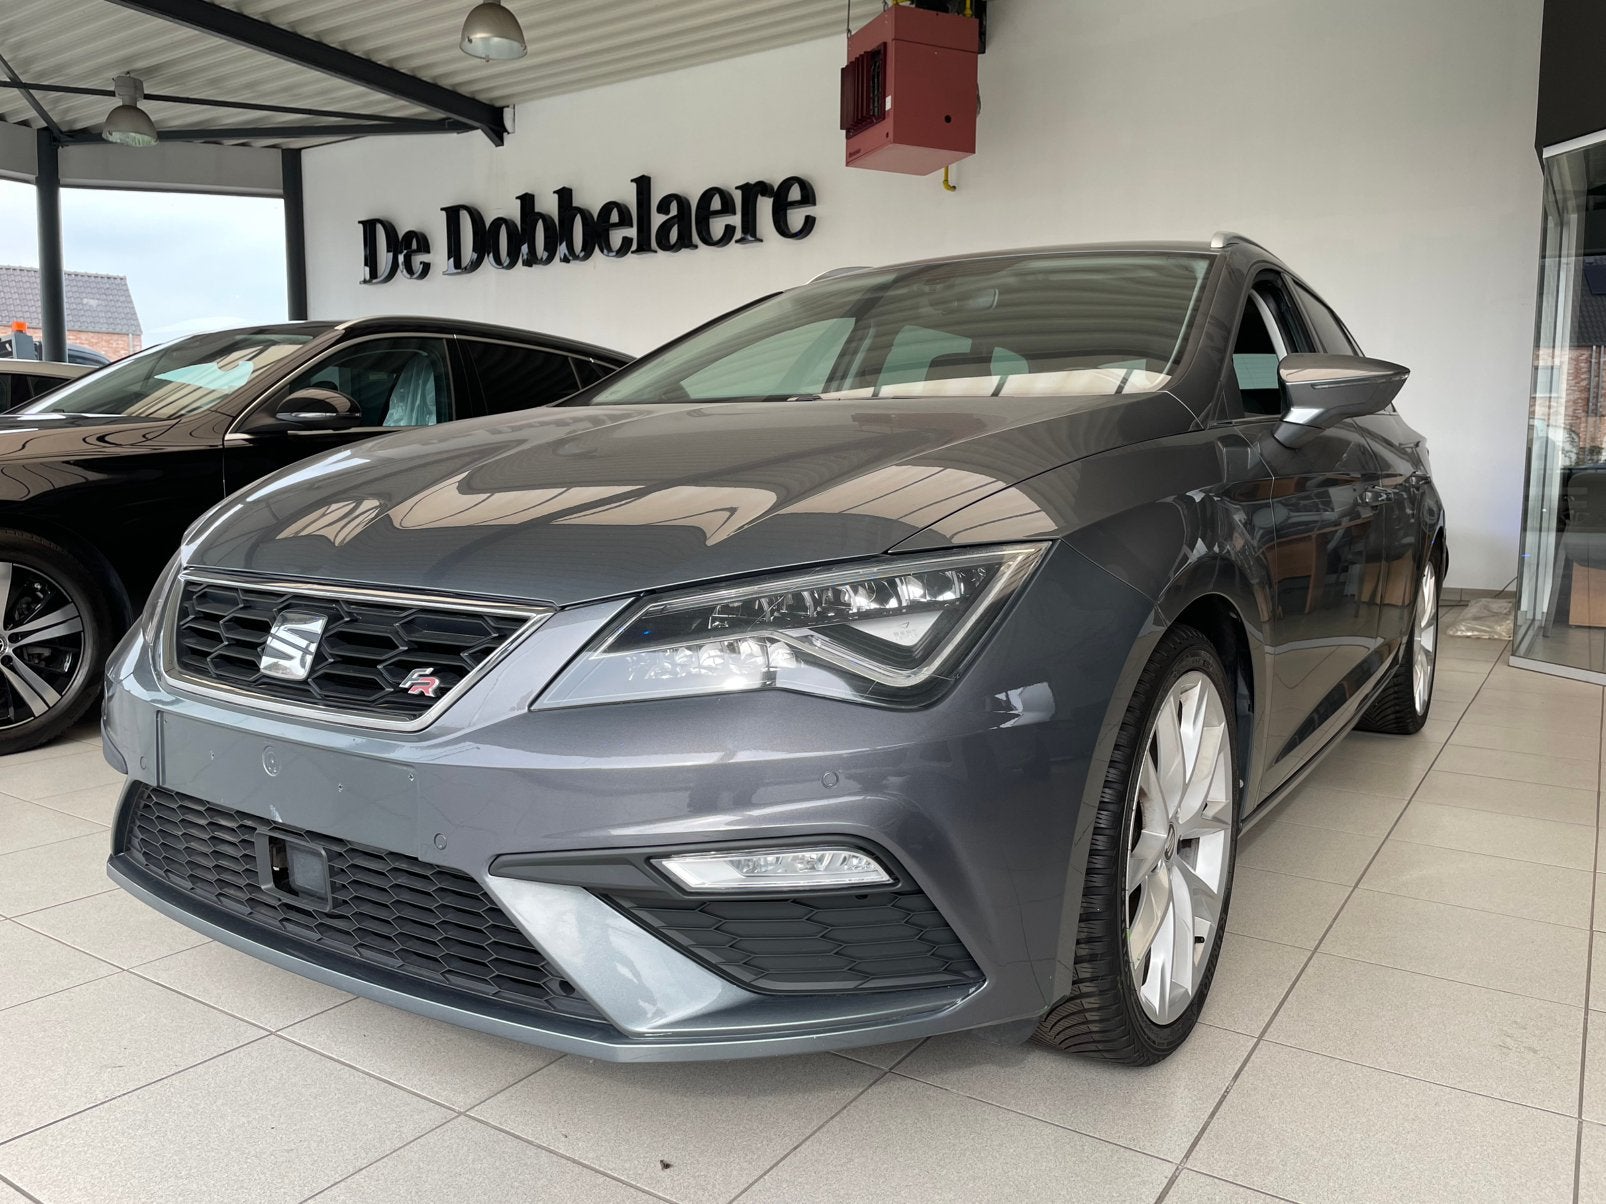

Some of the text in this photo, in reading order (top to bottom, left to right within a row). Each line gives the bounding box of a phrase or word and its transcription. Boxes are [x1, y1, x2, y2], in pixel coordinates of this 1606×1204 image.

[358, 174, 817, 284] De Dobbelaere
[399, 667, 440, 698] FR
